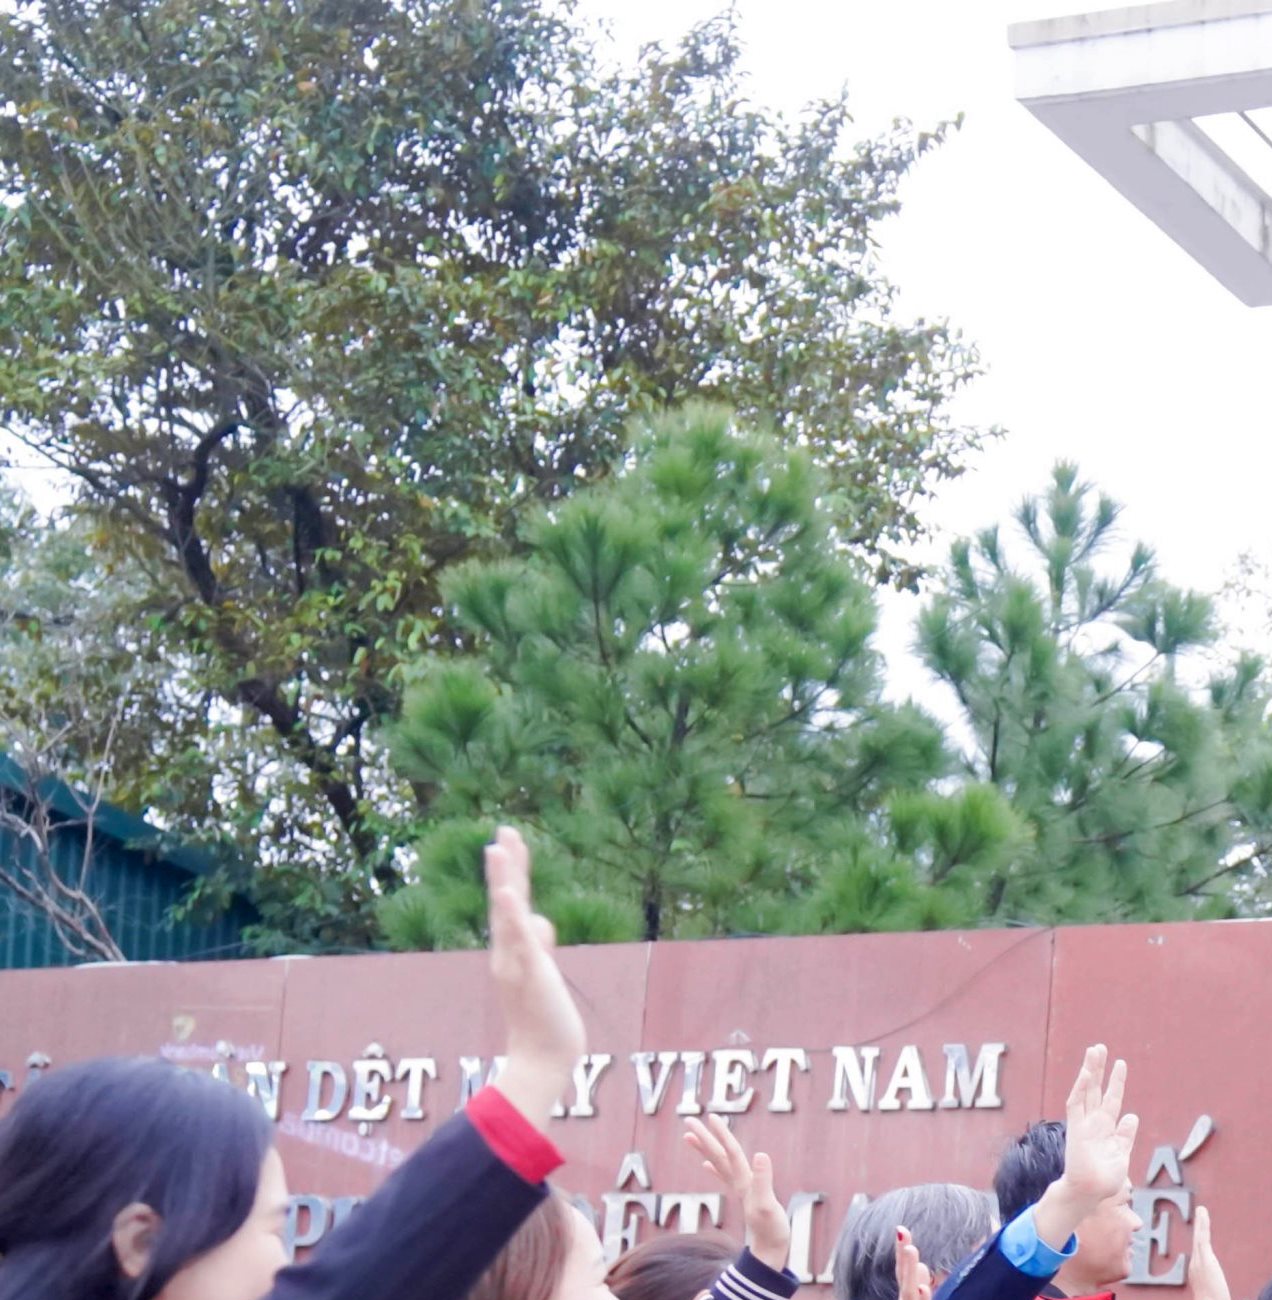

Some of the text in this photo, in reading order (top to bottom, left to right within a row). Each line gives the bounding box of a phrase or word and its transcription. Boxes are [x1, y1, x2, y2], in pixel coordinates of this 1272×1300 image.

[302, 1042, 438, 1136] DỆT
[630, 1030, 810, 1129] VIỆT
[828, 1042, 1006, 1112] NAM
